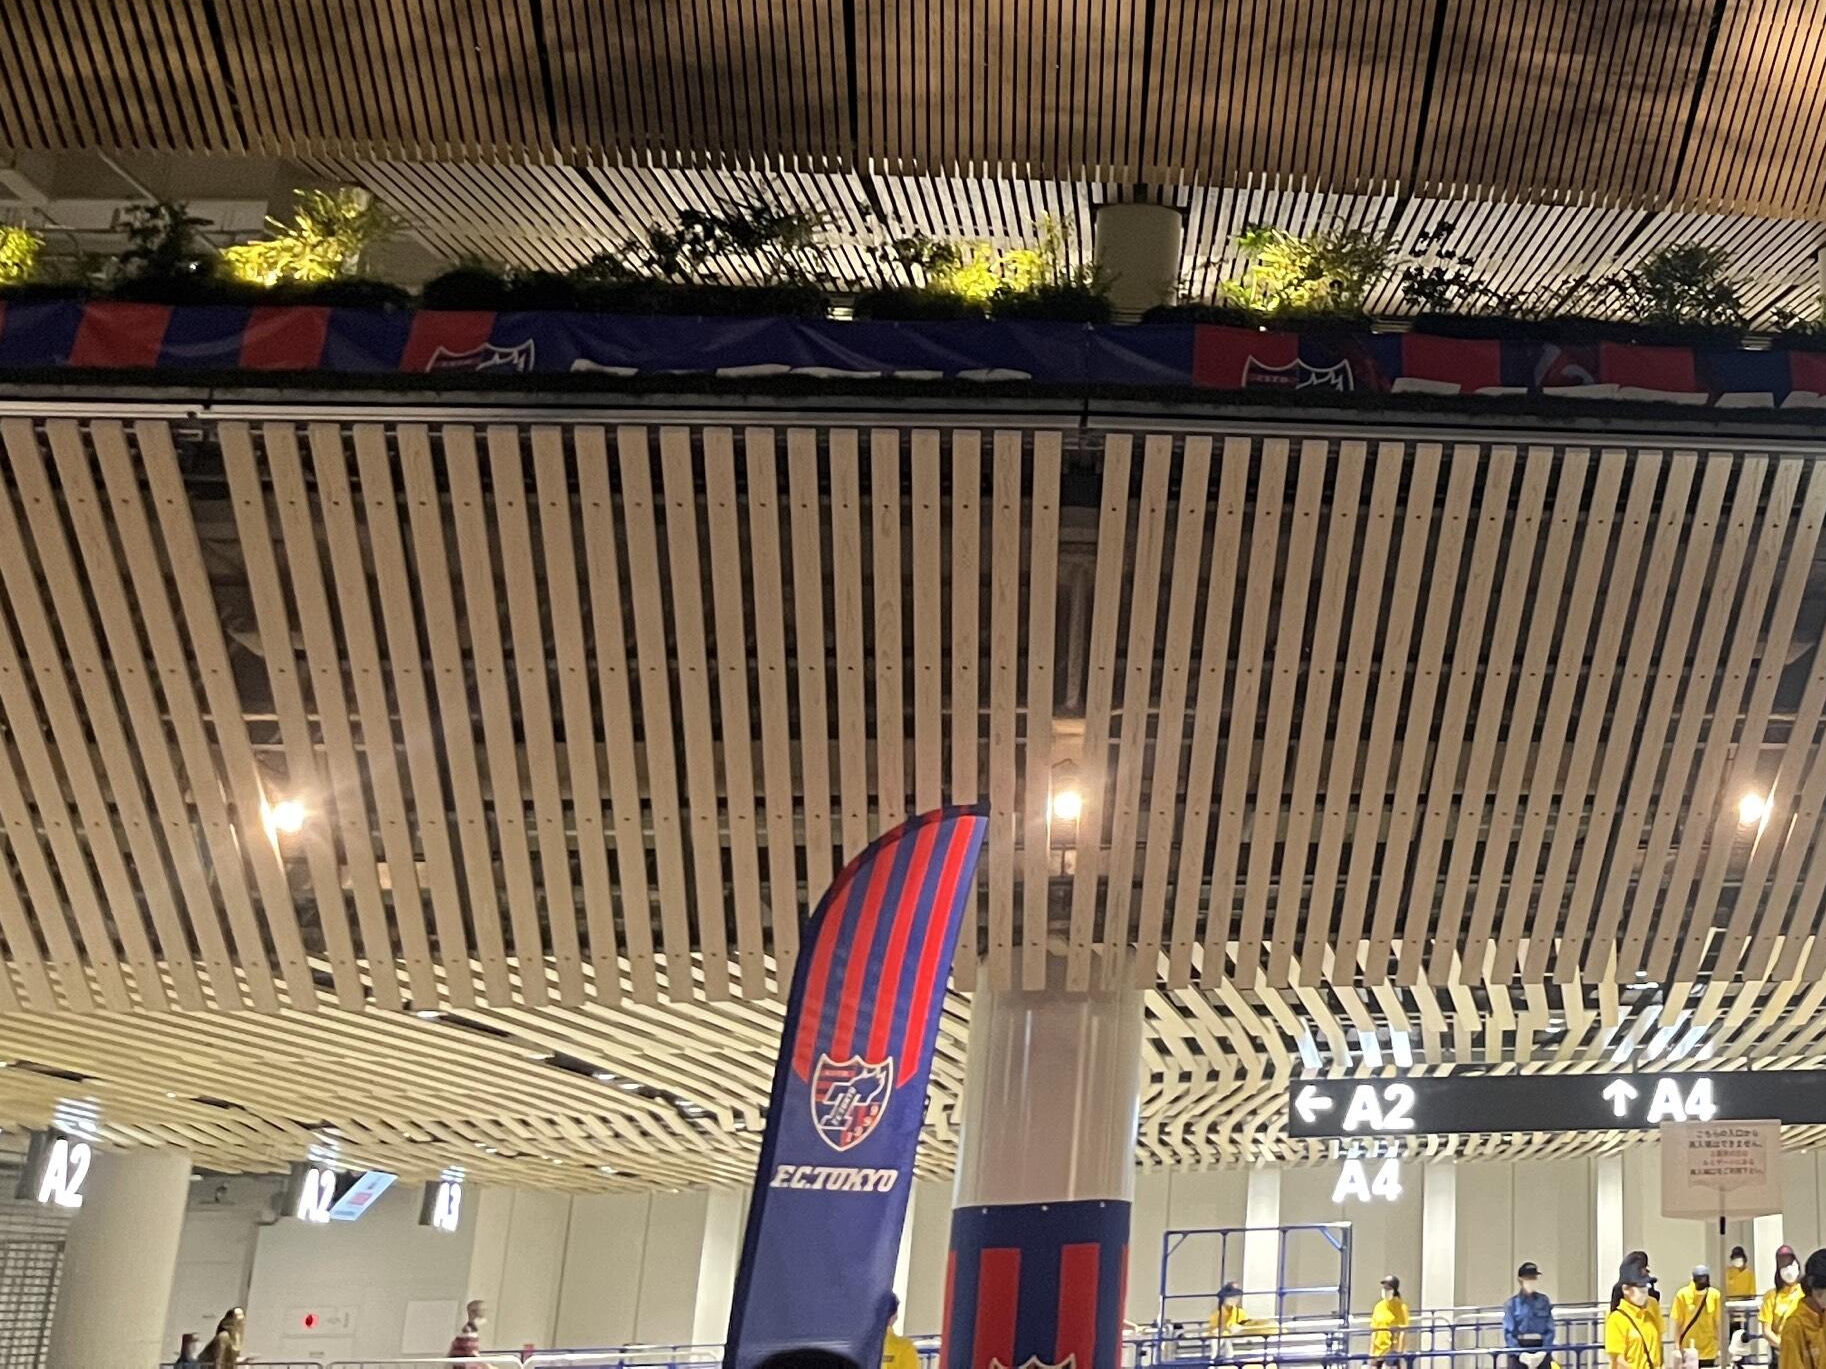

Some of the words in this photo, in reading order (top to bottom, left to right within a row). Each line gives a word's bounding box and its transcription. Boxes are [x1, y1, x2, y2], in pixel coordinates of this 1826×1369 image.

[1343, 1084, 1416, 1131] A2
[1647, 1077, 1718, 1123] A4
[37, 1139, 91, 1208] A2
[297, 1168, 337, 1224] A2
[1331, 1157, 1402, 1203] A4
[433, 1182, 462, 1231] A3
